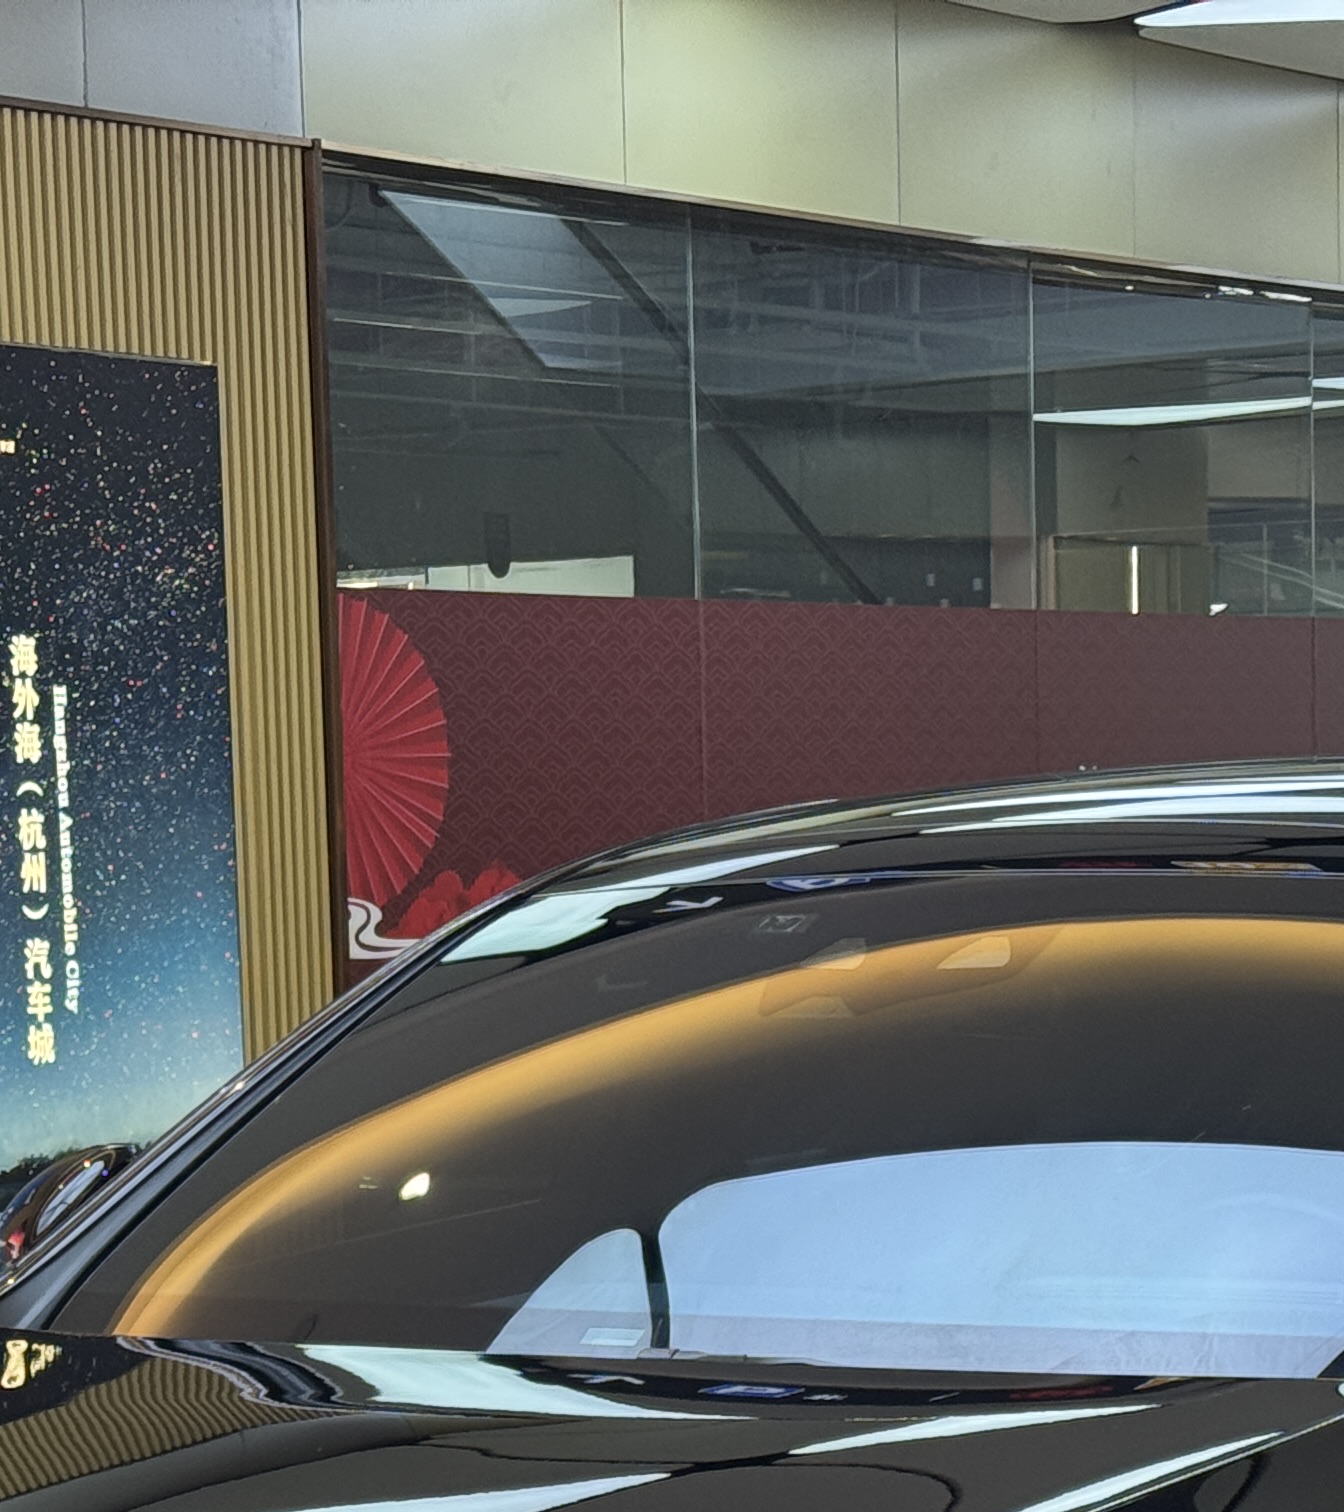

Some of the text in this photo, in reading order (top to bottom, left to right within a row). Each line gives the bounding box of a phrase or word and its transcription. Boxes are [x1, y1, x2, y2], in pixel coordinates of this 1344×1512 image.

[52, 684, 82, 1014] Hangzhou Automobile City
